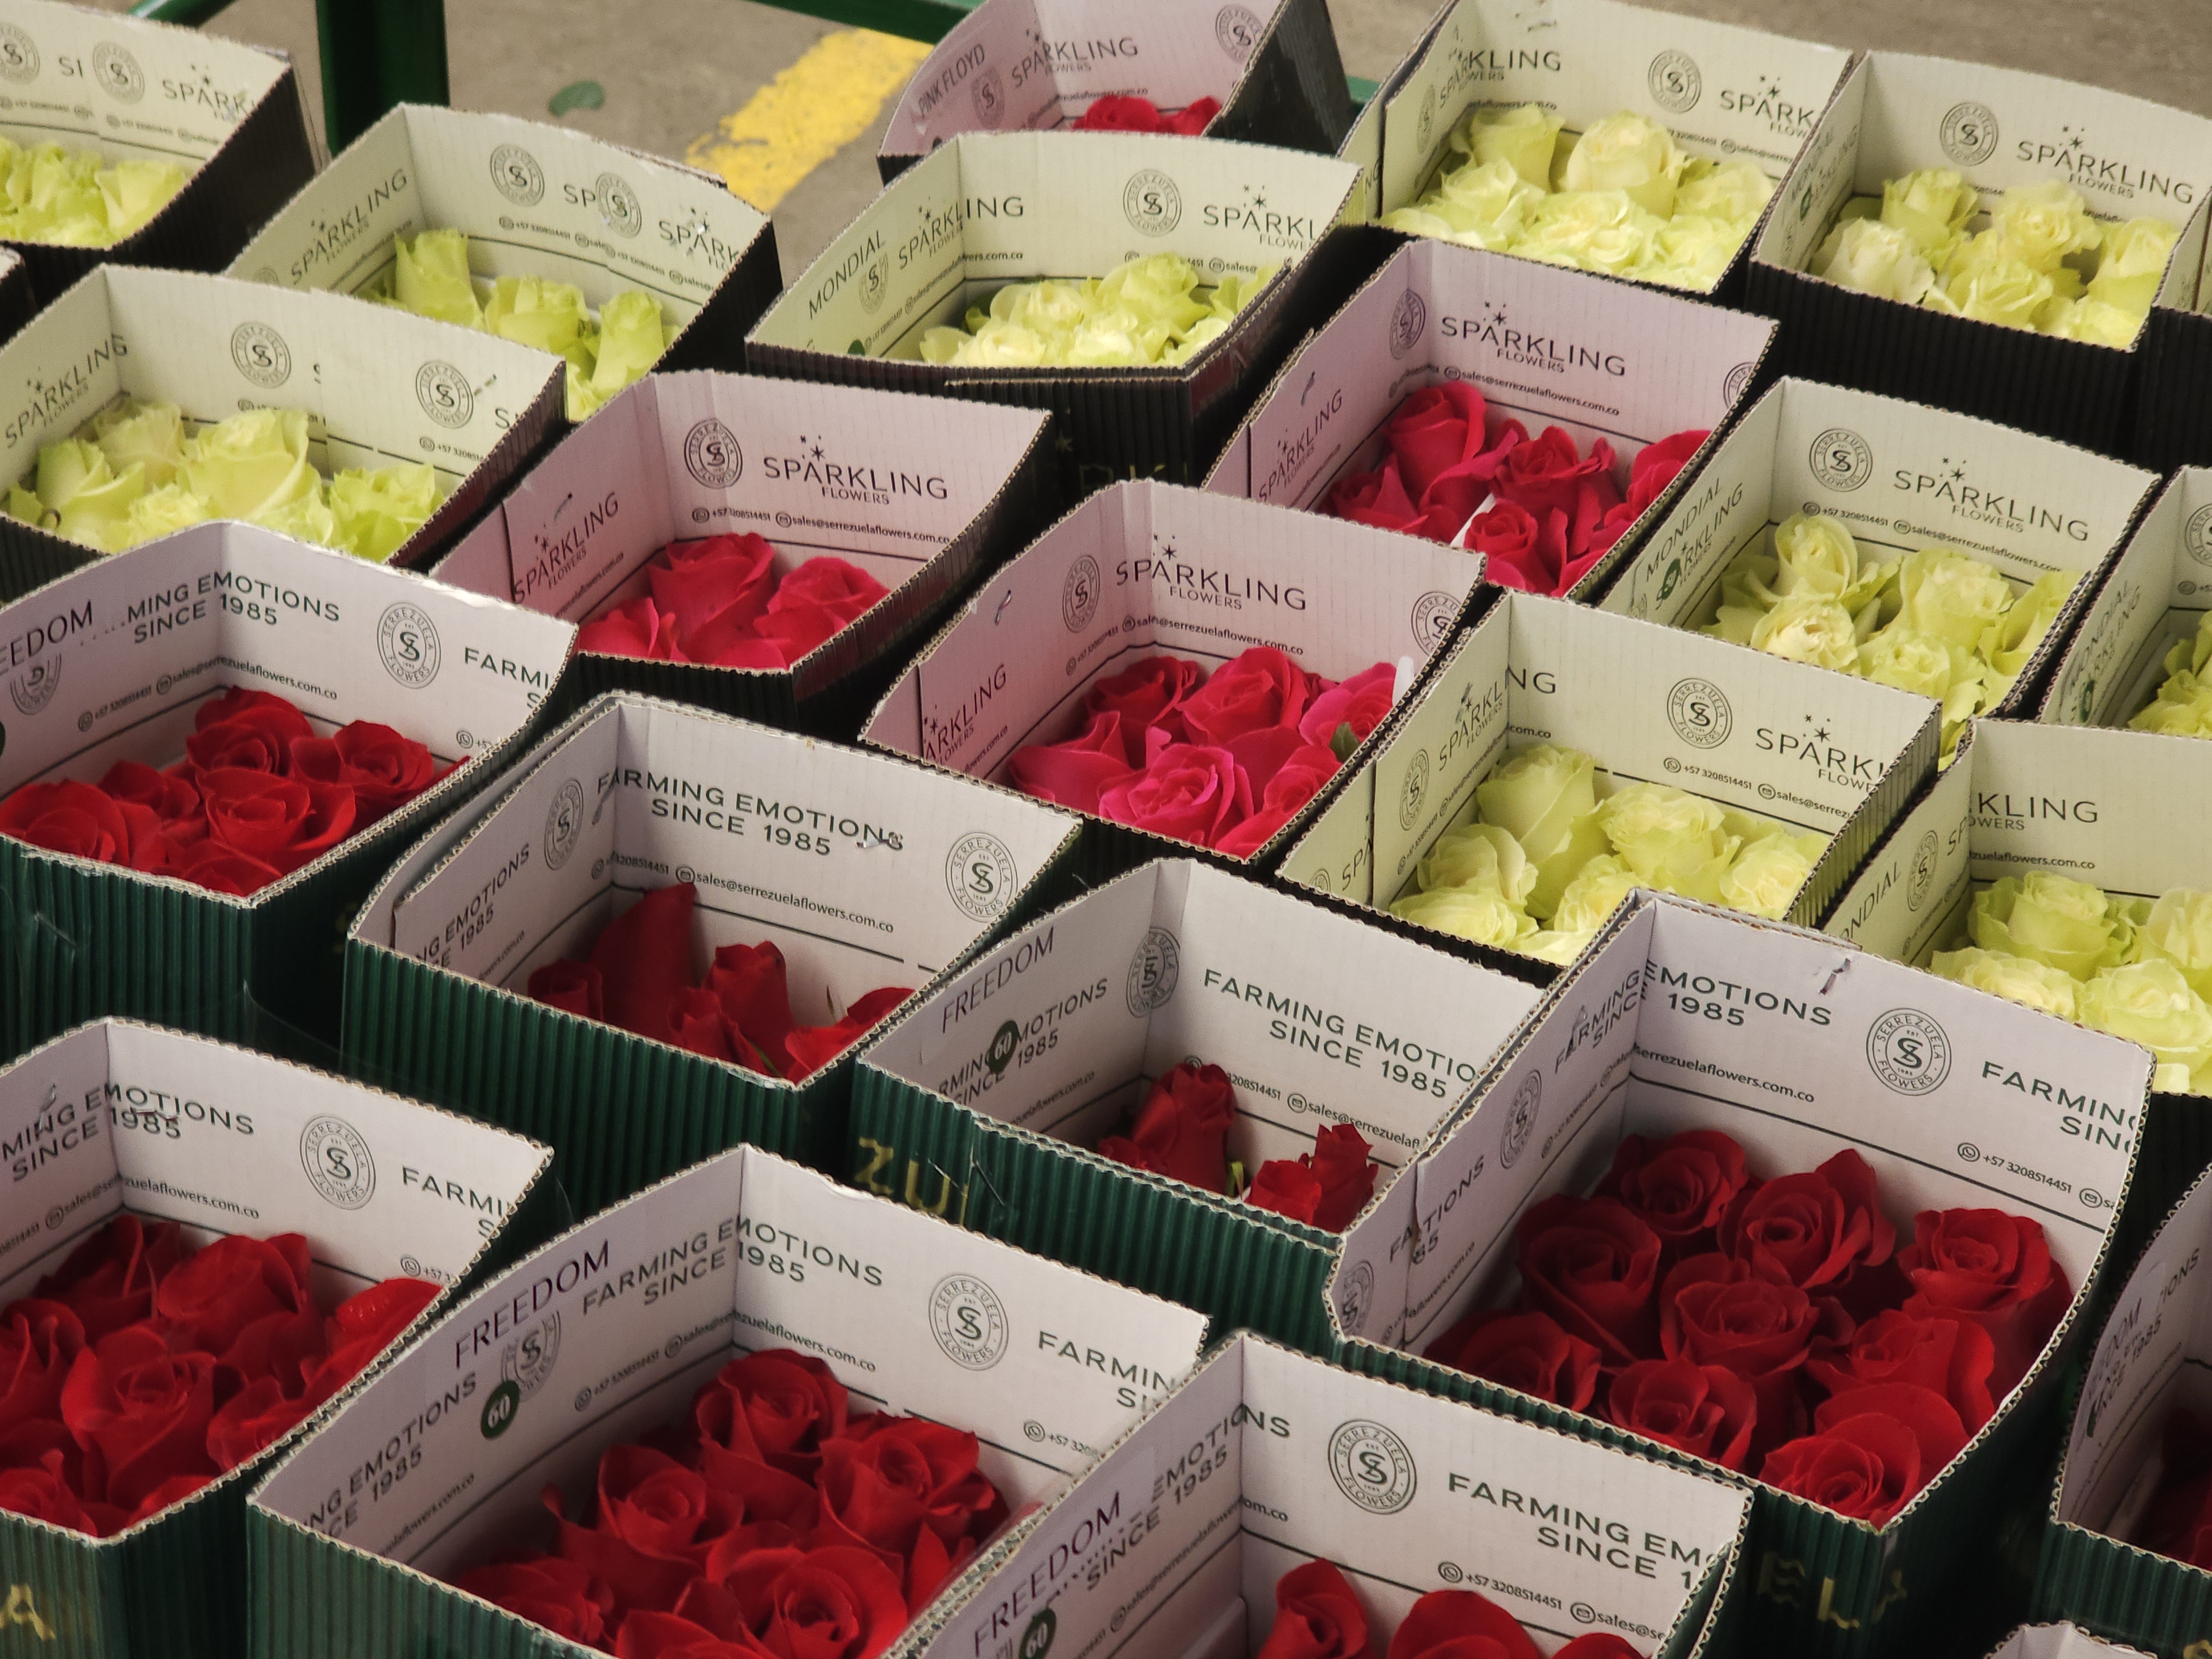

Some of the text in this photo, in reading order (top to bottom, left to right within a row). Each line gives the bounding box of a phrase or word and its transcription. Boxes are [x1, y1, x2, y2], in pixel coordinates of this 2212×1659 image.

[942, 43, 985, 91] FLOYD
[1011, 36, 1138, 88] SPARKLING
[1720, 90, 1815, 128] SPARK
[564, 184, 596, 208] SP
[2016, 140, 2193, 205] SPARKLING
[2068, 173, 2135, 199] FLOWERS
[290, 168, 408, 285] SPARKLING
[899, 197, 1024, 270] SPARKLING
[808, 230, 886, 320] MONDIAL
[1441, 316, 1626, 376] SPARKLING
[1496, 348, 1564, 373] FLOWERS
[4, 334, 128, 448] SPARKLING
[1259, 389, 1343, 501] SPARKLING
[764, 456, 948, 500] SPARKLING
[822, 487, 890, 505] FLOWERS
[1893, 469, 2089, 541] SPARKLING
[514, 492, 619, 603] SPARKLING
[1646, 477, 1721, 582] MONDIAL
[1952, 504, 2023, 533] FLOWERS
[197, 571, 340, 622] EMOTIONS
[1116, 559, 1307, 611] SPARKLING
[1170, 586, 1242, 610] FLOWERS
[134, 593, 277, 644] SINCE 1985
[1439, 665, 1556, 772] SPARKLING
[1683, 764, 1752, 790] +57 3208514451
[597, 768, 905, 852] FARMING EMOTIONS
[651, 799, 831, 856] SINCE 1985
[446, 843, 530, 942] EMOTIONS
[696, 870, 894, 934] sales@serrezuelaflowers.com.co
[461, 903, 494, 950] 1985
[942, 927, 1055, 1034] FREEDOM
[1668, 993, 1745, 1026] 1985
[1204, 968, 1477, 1083] FARMING EMOTIO
[1555, 958, 1832, 1074] FARMING EMOTIONS
[1876, 1014, 1943, 1061] SERREZUELA
[1018, 1029, 1058, 1068] 1985
[1270, 1020, 1446, 1099] SINCE 1985
[85, 1083, 254, 1135] EMOTIONS
[12, 1107, 181, 1182] SINCE 1985
[1983, 1154, 2072, 1194] +57 3208514451
[583, 1215, 882, 1315] FARMING EMOTIONS
[644, 1241, 805, 1306] SINCE 1985
[454, 1240, 609, 1370] FREEDOM
[349, 1371, 477, 1495] EMOTIONS
[1151, 1403, 1291, 1503] EMOTIONS
[372, 1443, 422, 1501] 1985
[1087, 1506, 1161, 1592] SINCE
[1173, 1444, 1227, 1505] 1985
[1448, 1473, 1630, 1545] FARMING
[974, 1490, 1121, 1658] FREEDOM
[1538, 1526, 1657, 1579] SINCE
[1465, 1572, 1563, 1611] +57 3208514451
